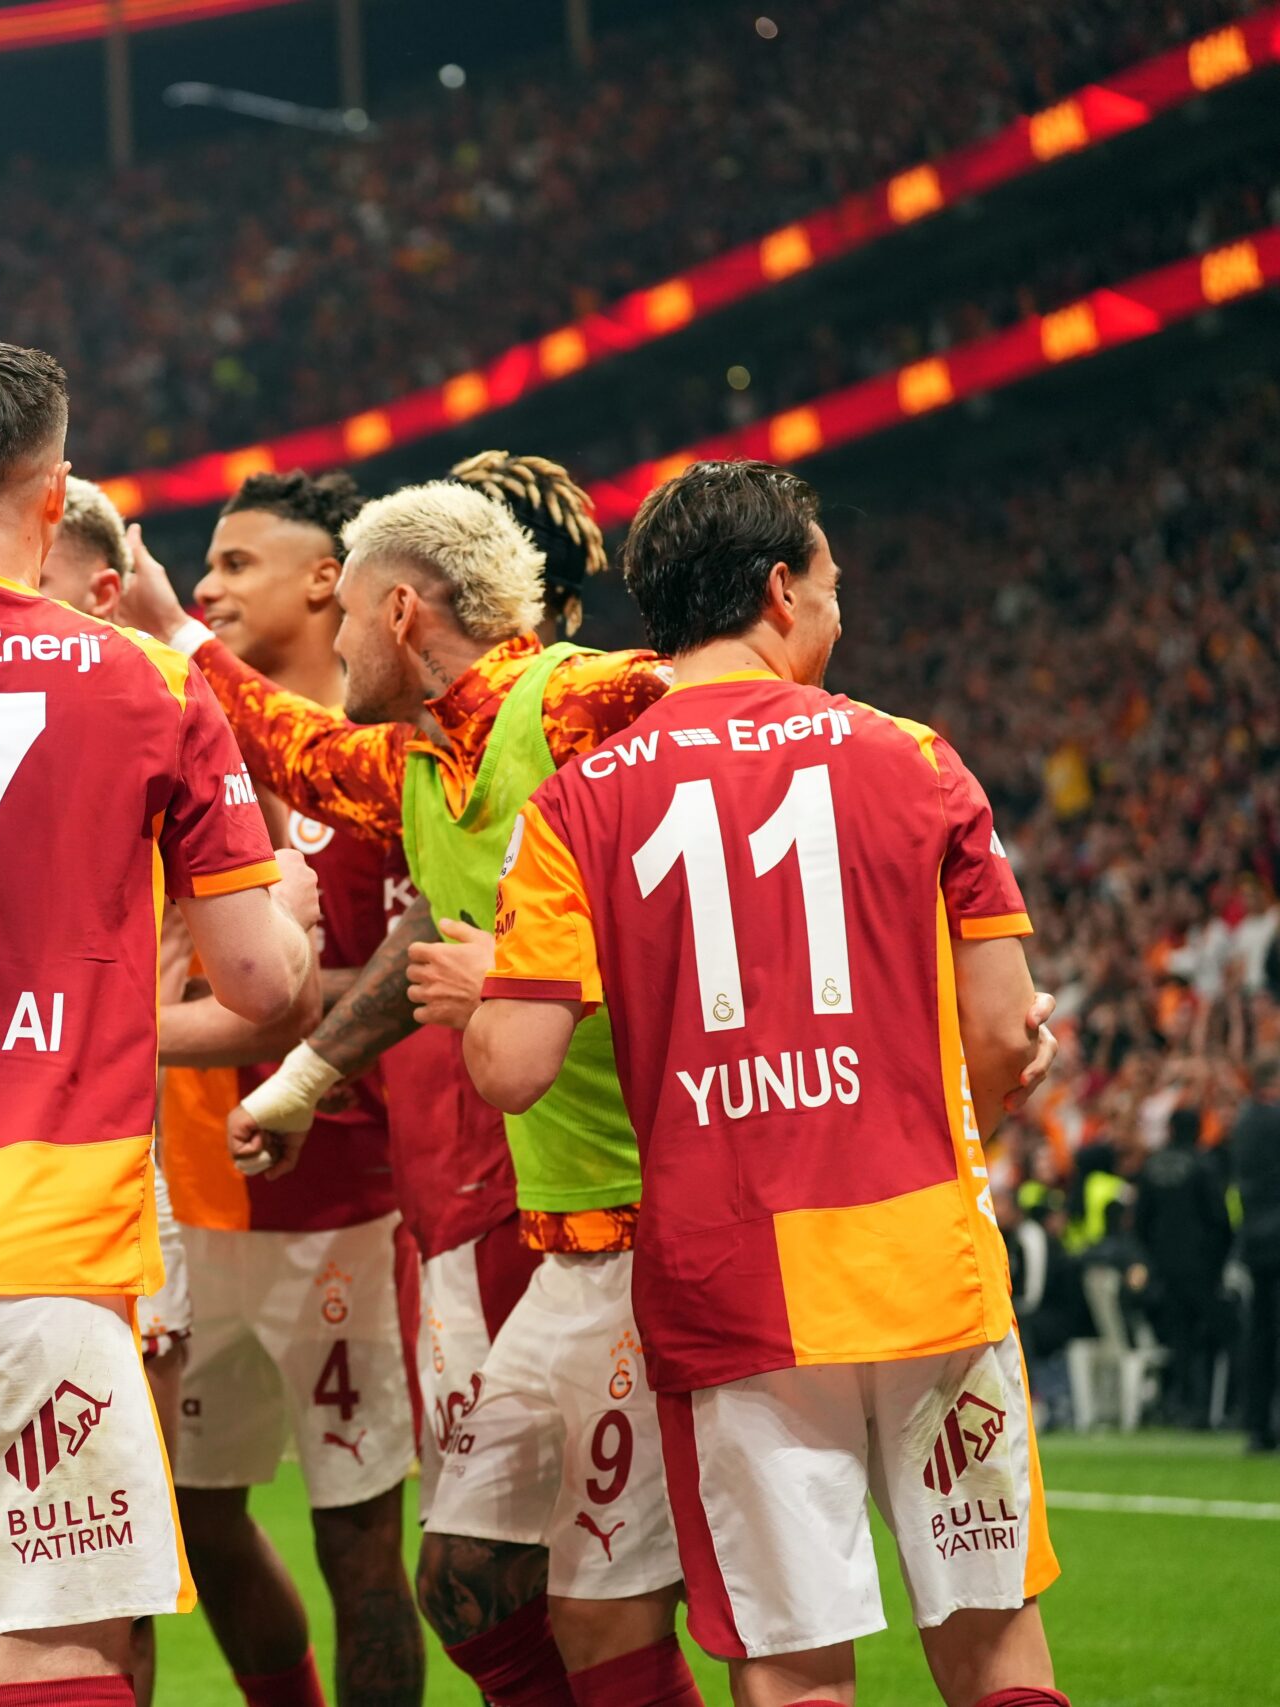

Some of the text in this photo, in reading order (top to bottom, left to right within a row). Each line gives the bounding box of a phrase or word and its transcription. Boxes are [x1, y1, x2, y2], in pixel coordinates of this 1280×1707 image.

[580, 706, 852, 779] CW Enerji
[223, 762, 259, 806] mi
[631, 763, 854, 1033] 11
[675, 1045, 861, 1126] YUNUS
[313, 1339, 361, 1422] 4
[585, 1409, 635, 1505] 9
[7, 1489, 130, 1537] BULLS
[11, 1520, 134, 1564] YATIRIM
[931, 1498, 1018, 1539] BULL
[935, 1525, 1020, 1561] YATIRI
